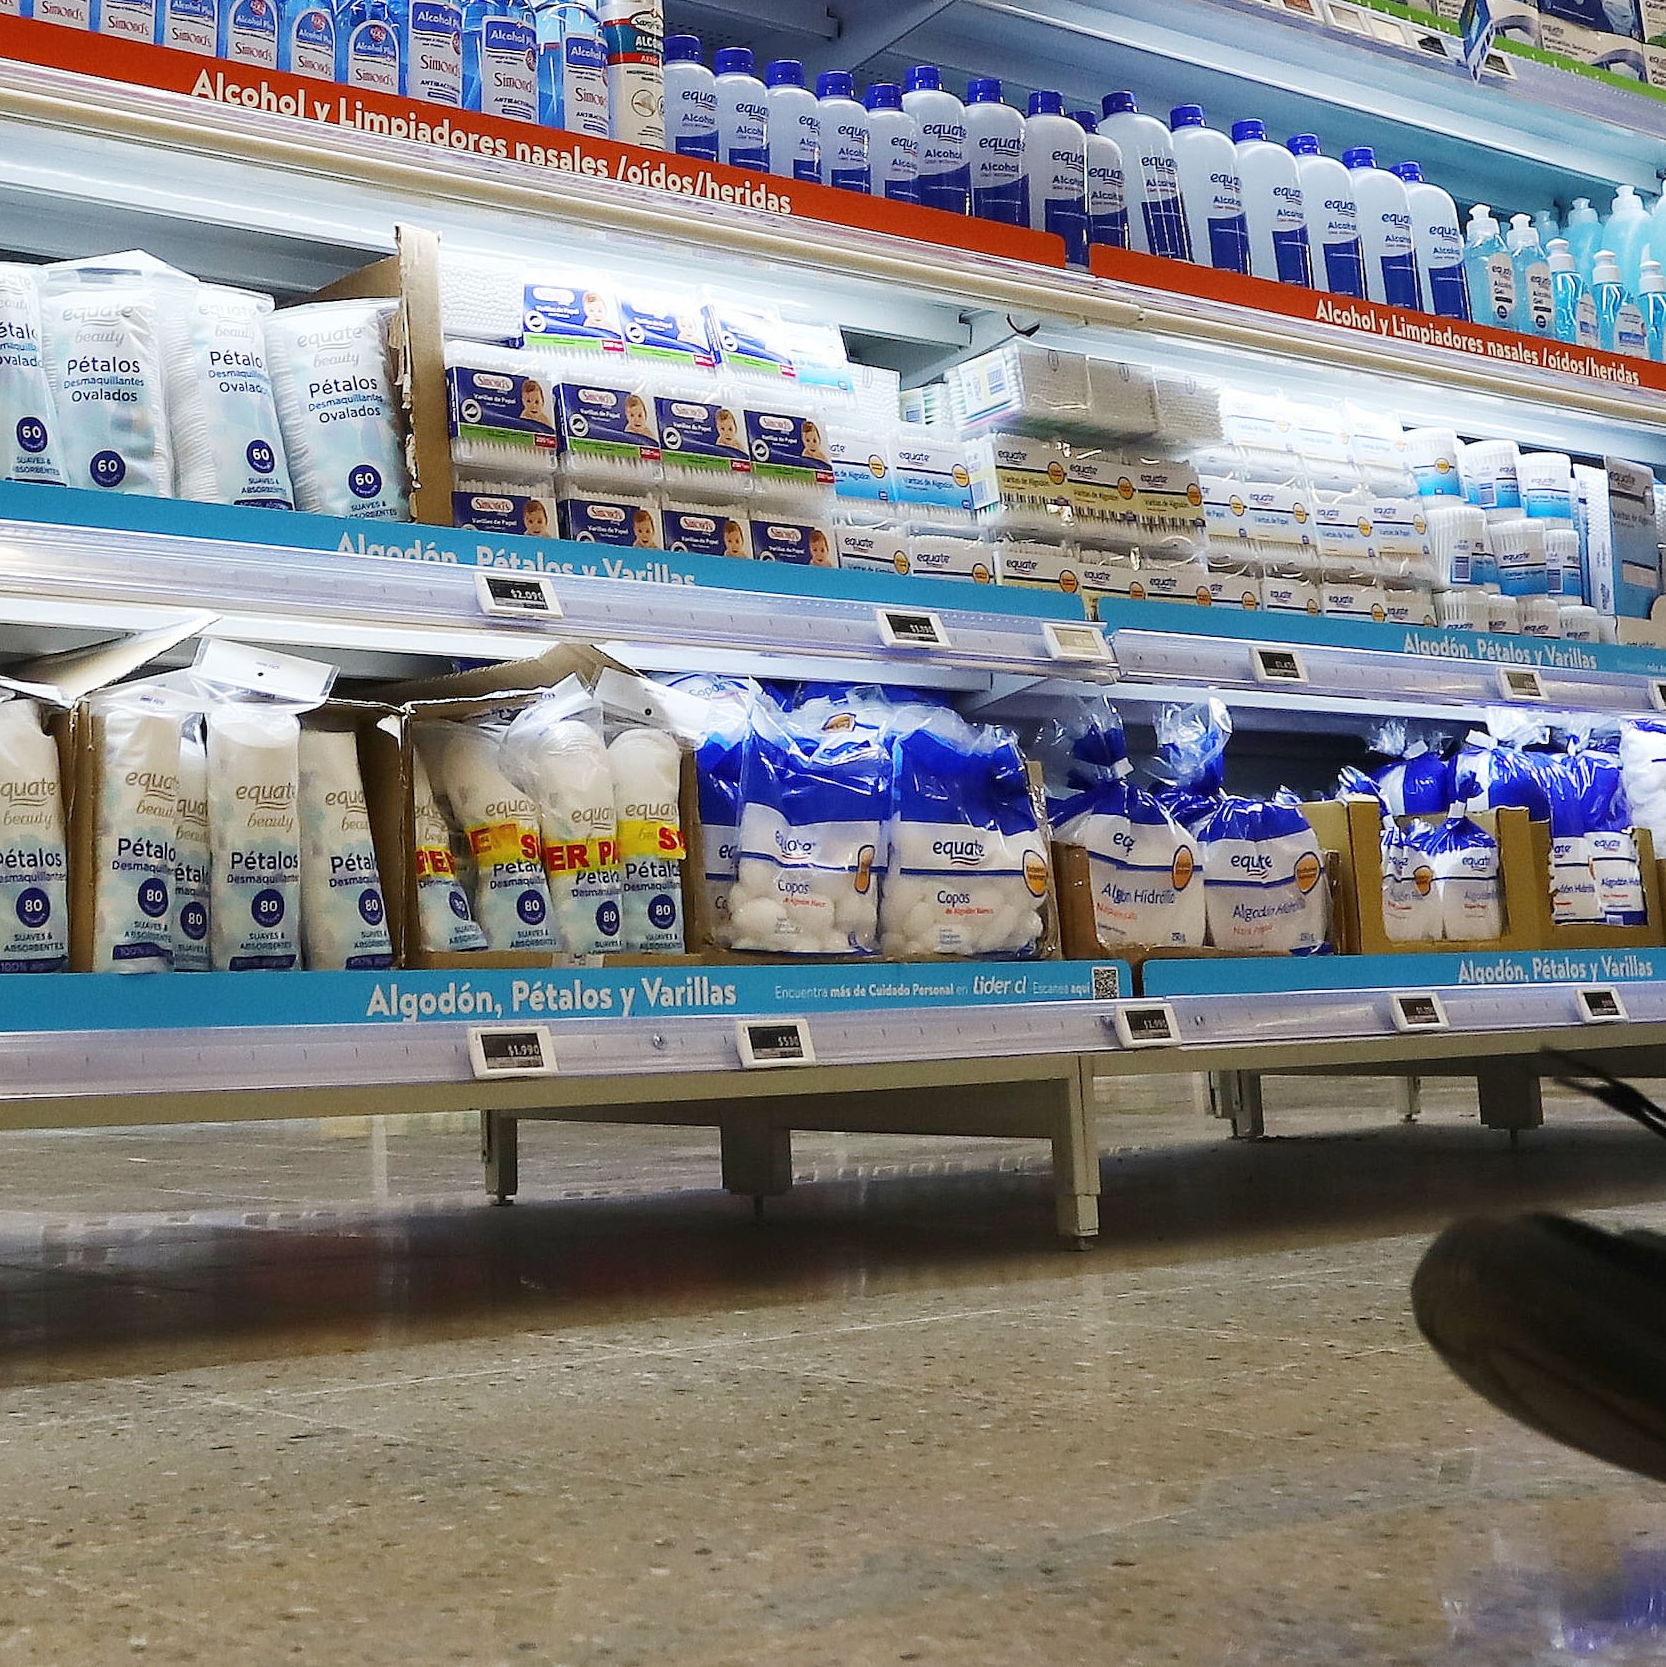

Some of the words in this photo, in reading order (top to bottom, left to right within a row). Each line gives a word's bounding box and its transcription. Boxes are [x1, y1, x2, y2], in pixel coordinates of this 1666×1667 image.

[417, 9, 451, 27] Alcohol
[491, 29, 525, 44] Alcohol
[571, 45, 602, 61] Alcohol
[683, 112, 715, 125] Alcohol
[191, 68, 306, 120] Alcohol
[313, 101, 330, 122] y
[338, 96, 507, 160] Limpiadores
[515, 140, 608, 179] nasales
[617, 152, 792, 215] /oídos/heridas
[925, 149, 962, 159] Alcohol
[981, 162, 1019, 173] Alcohol
[75, 328, 125, 347] beauty
[1316, 300, 1377, 333] Alcohol
[1380, 315, 1389, 336] y
[1393, 315, 1484, 355] Limpiadores
[1488, 341, 1538, 365] nasales
[1542, 348, 1640, 386] /oídos/heridas
[67, 356, 140, 377] Pétalos
[313, 350, 360, 369] beauty
[63, 375, 144, 388] Desmaquillantes
[308, 374, 379, 397] Pétalos
[71, 388, 137, 402] Ovalados
[308, 393, 383, 412] Desmaquillantes
[319, 402, 381, 423] Ovalados
[21, 425, 42, 439] 60
[252, 447, 270, 462] 60
[97, 459, 118, 473] 60
[354, 471, 374, 486] 60
[3, 812, 52, 829] beauty
[146, 890, 162, 903] 80
[24, 899, 43, 912] 80
[260, 900, 278, 913] 80
[364, 899, 378, 911] 80
[524, 899, 540, 912] 80
[656, 904, 671, 916] 80
[188, 913, 202, 926] 80
[603, 911, 616, 923] 80
[4, 942, 64, 952] ABSORBENTES
[1458, 957, 1530, 985] Algodón,
[1533, 956, 1589, 980] Pétalos
[1601, 955, 1653, 977] Varillas
[774, 985, 827, 999] Encuentra
[830, 986, 851, 997] más
[854, 985, 866, 996] de
[868, 983, 910, 997] Cuidado
[912, 983, 954, 996] Personal
[956, 986, 968, 995] en
[1033, 982, 1068, 994] Escanea
[1070, 982, 1090, 995] aquí
[366, 981, 502, 1022] Algodón,
[513, 980, 612, 1010] Pétalos
[620, 986, 635, 1017] y
[642, 975, 736, 1005] Varillas
